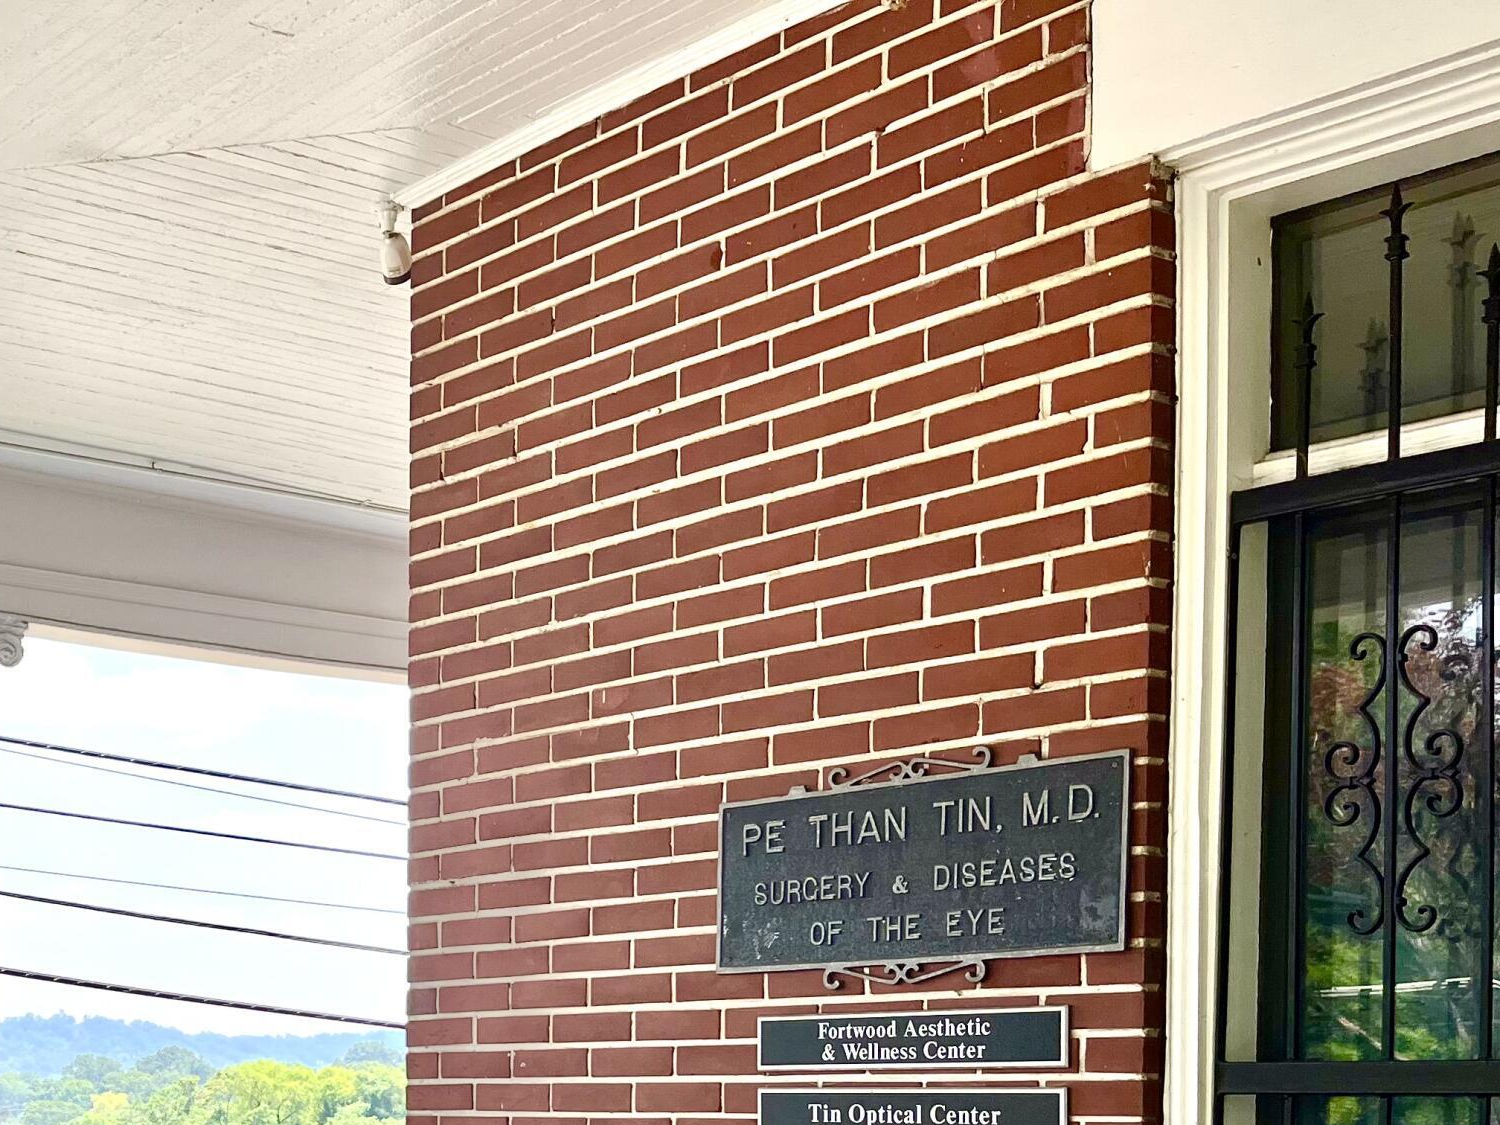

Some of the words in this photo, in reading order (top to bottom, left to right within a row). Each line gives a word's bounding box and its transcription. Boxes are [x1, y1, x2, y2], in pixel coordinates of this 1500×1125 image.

[742, 818, 786, 857] PE
[808, 806, 907, 849] THAN
[933, 796, 1003, 837] TIN,
[1022, 783, 1101, 828] M.D.
[753, 871, 870, 906] SURGERY
[892, 875, 909, 895] &
[933, 852, 1077, 892] DISEASES
[809, 919, 843, 946] OF
[867, 913, 921, 943] THE
[946, 907, 1005, 938] EYE
[818, 1020, 897, 1041] Fortwood
[904, 1018, 991, 1038] Aesthetic
[821, 1044, 836, 1062] &
[842, 1042, 917, 1061] Wellness
[923, 1041, 986, 1060] Center
[808, 1103, 842, 1124] Tin
[929, 1105, 1001, 1125] Center
